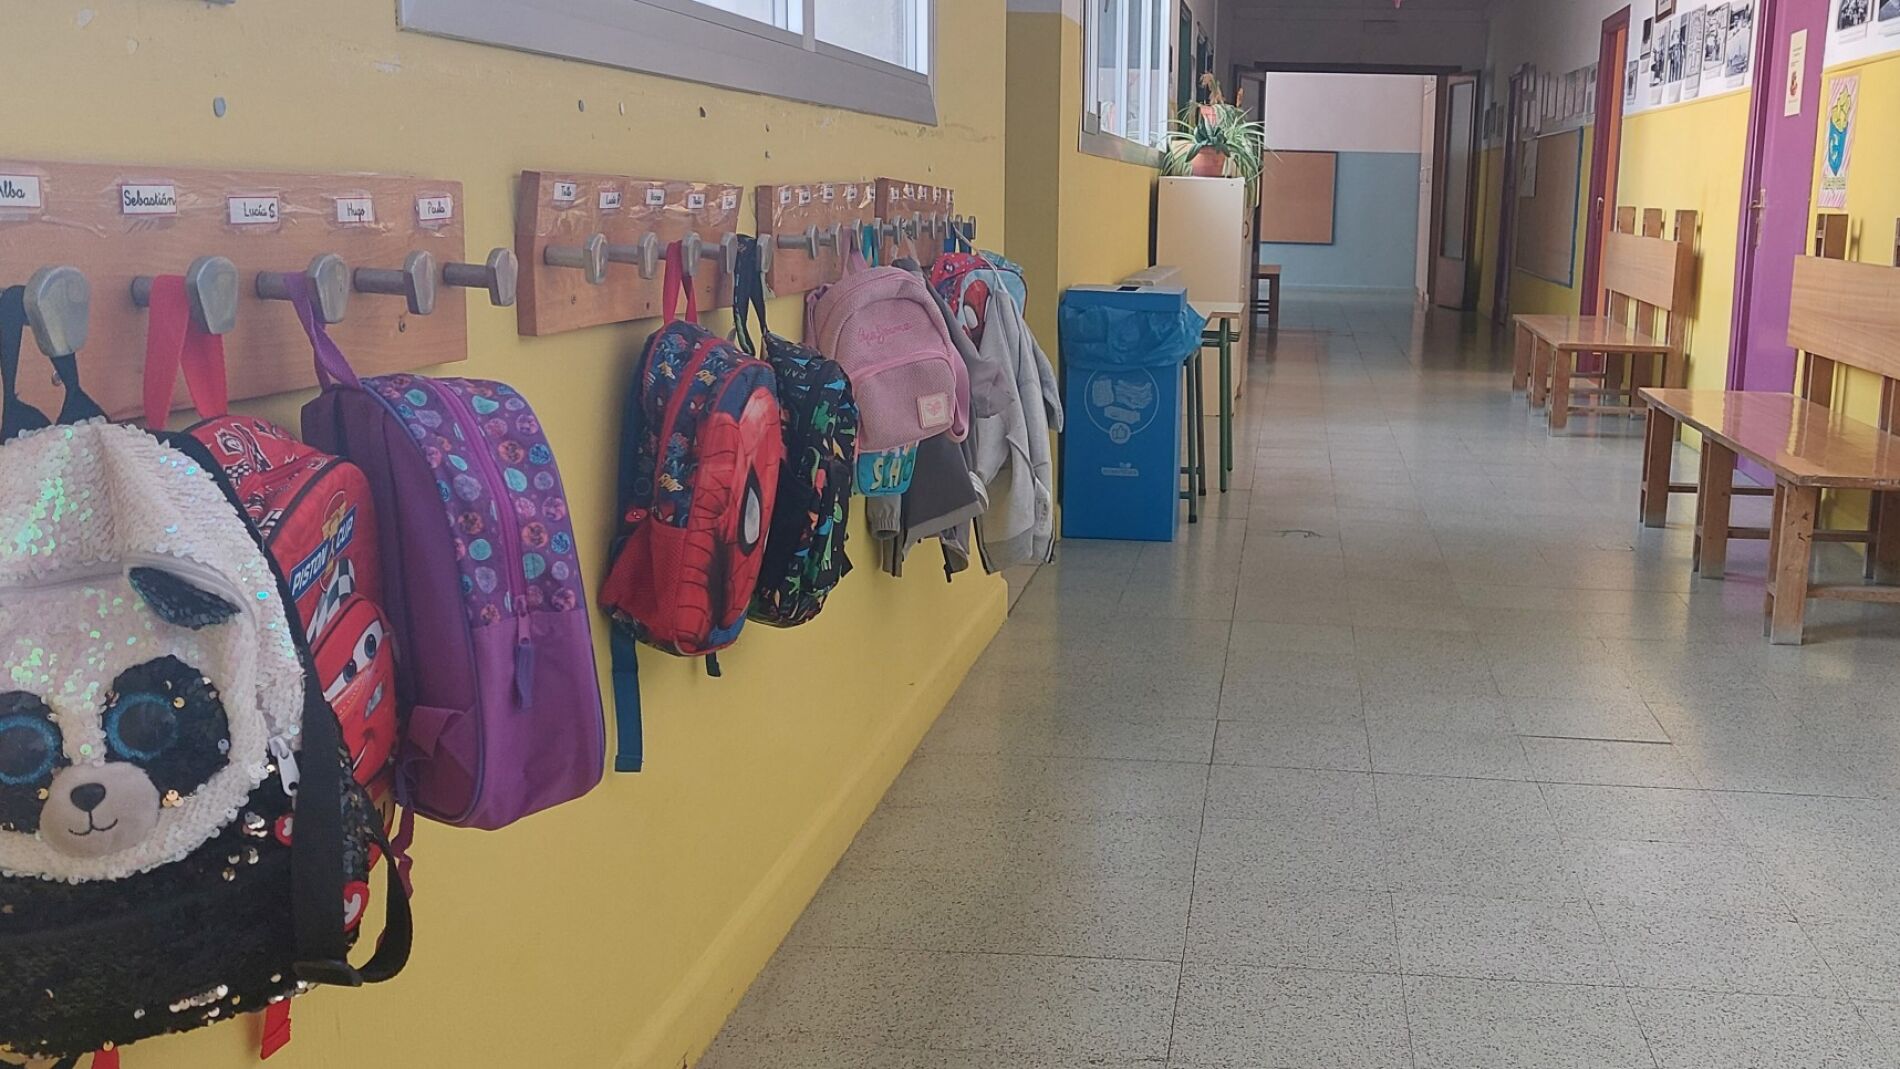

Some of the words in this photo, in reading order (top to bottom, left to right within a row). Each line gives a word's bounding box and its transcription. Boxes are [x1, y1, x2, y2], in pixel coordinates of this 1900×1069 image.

[123, 189, 177, 207] Sebastián
[346, 202, 366, 223] Hugo
[291, 543, 329, 596] PISTON
[336, 514, 354, 549] CUP
